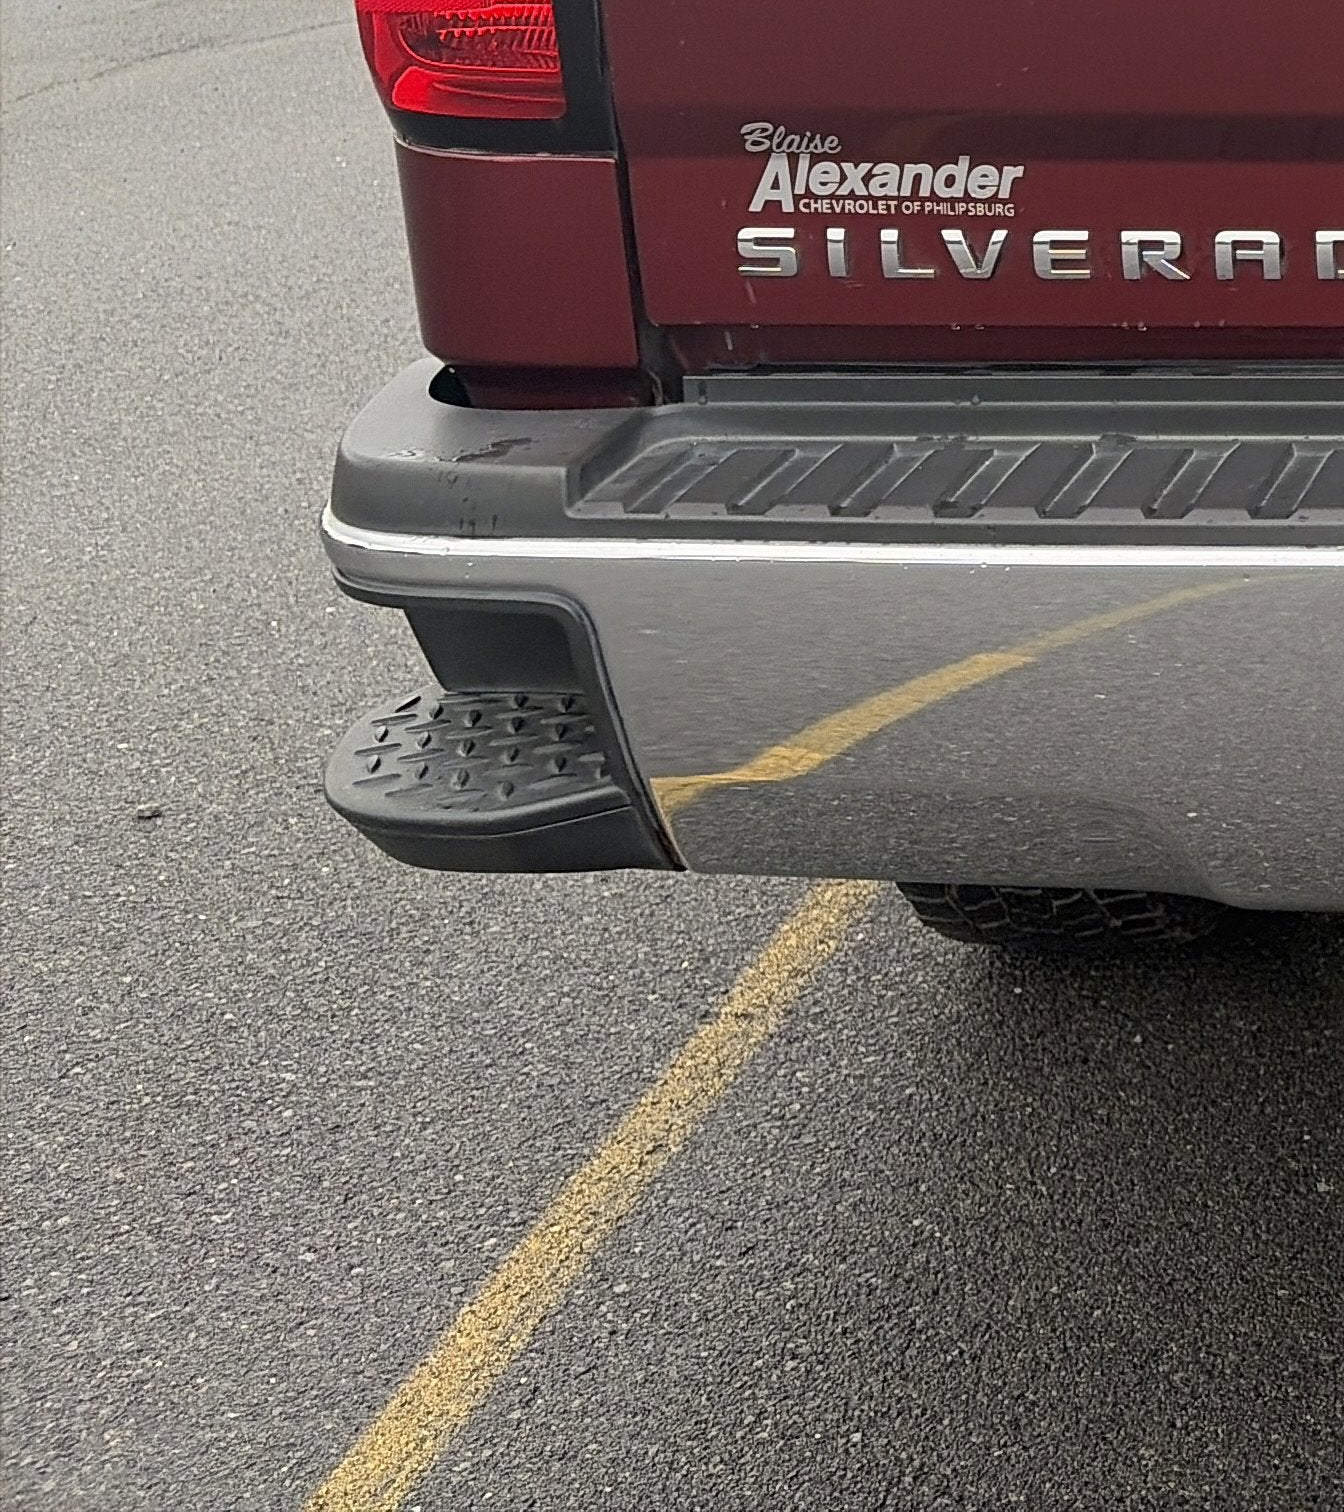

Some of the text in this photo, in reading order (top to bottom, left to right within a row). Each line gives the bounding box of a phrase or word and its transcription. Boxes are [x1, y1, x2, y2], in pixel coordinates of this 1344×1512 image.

[740, 122, 842, 154] Blaise
[748, 153, 1025, 212] Alexander
[799, 198, 1016, 217] CHEVROLET OF PHILIPSBURG
